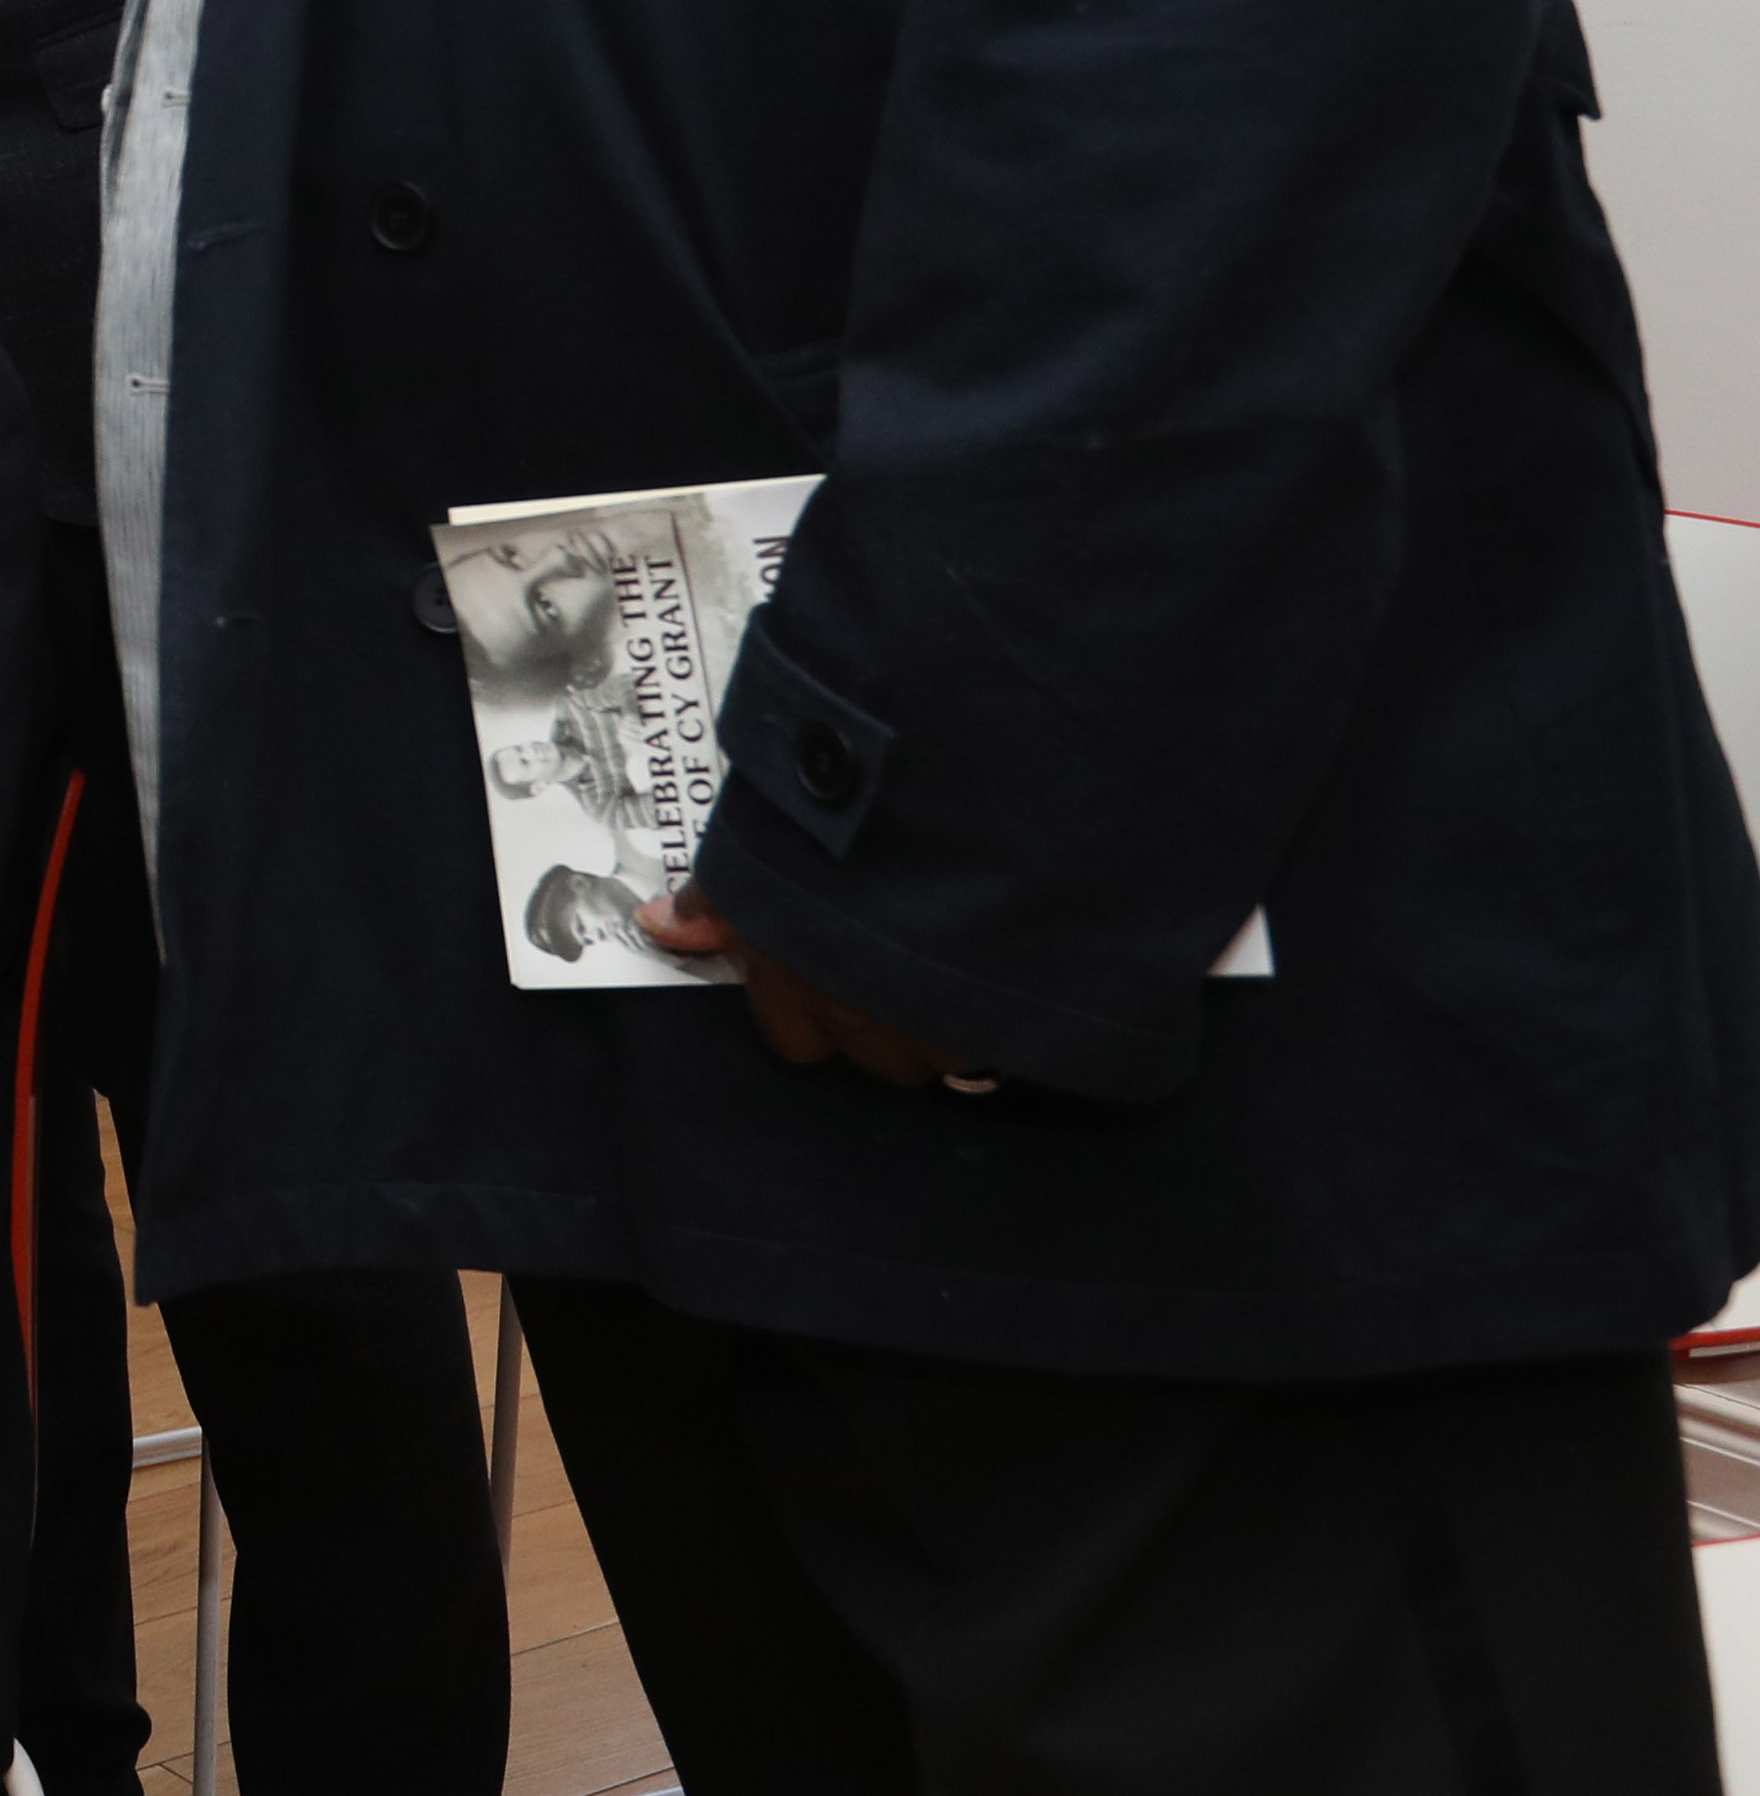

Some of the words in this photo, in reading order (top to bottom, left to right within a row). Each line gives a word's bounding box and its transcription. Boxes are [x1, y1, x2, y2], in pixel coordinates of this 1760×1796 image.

[611, 555, 648, 628] THE
[647, 557, 694, 681] GRANT
[672, 694, 705, 744] CY
[684, 756, 714, 806] OF
